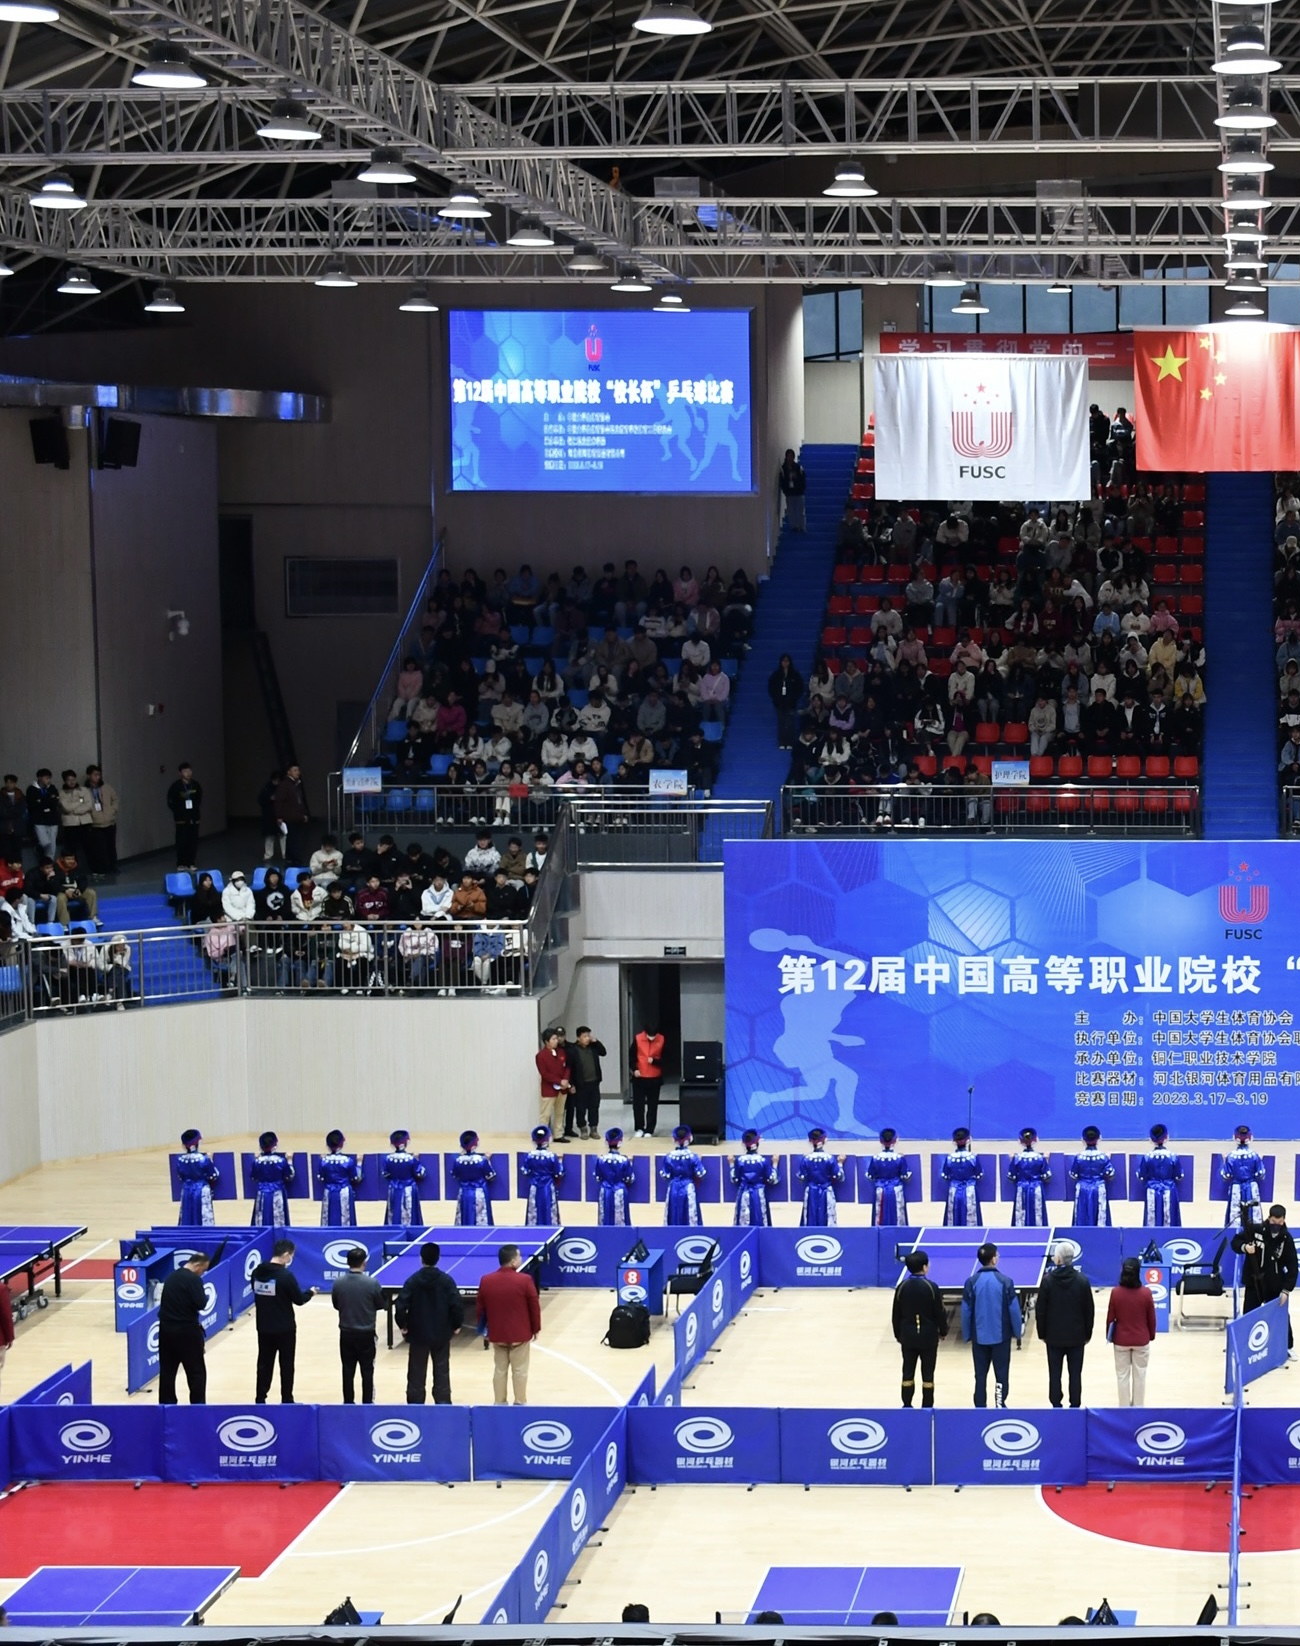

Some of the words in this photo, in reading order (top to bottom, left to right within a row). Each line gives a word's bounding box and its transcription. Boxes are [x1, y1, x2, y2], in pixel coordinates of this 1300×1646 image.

[959, 465, 1006, 479] FUSC
[1224, 928, 1263, 941] FUSC
[122, 1269, 136, 1282] 10
[560, 1265, 597, 1274] YINHE
[1150, 1269, 1159, 1281] 3
[1171, 1266, 1203, 1274] INHE
[628, 1271, 637, 1283] 8
[147, 1353, 160, 1366] YIN
[1247, 1347, 1269, 1365] YINHE
[61, 1454, 112, 1464] YINHE
[372, 1453, 422, 1463] YINHE
[523, 1455, 572, 1465] YINHE
[1136, 1456, 1185, 1466] YINHE
